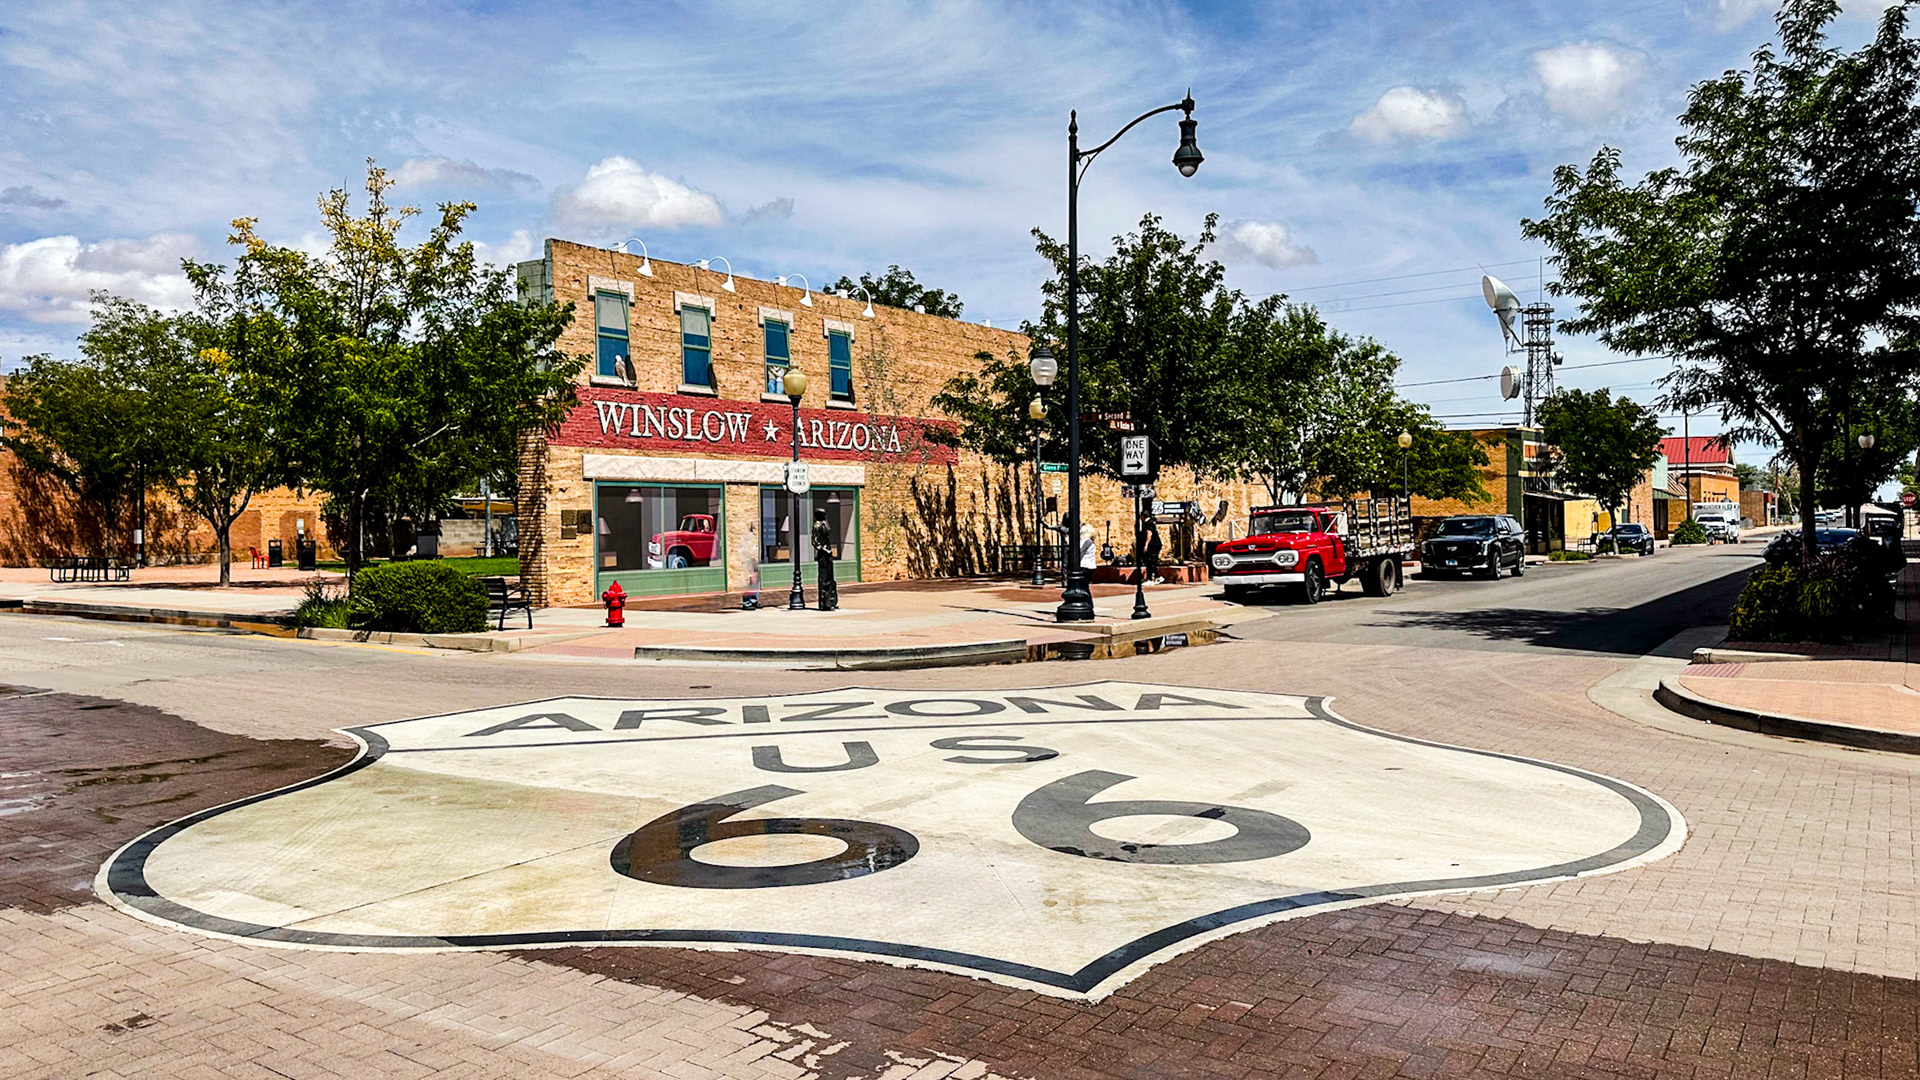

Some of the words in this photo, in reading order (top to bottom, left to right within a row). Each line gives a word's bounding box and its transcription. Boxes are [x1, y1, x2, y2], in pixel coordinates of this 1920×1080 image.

[593, 400, 752, 444] WINSLOW
[790, 417, 902, 453] ARIZONA
[1126, 440, 1145, 449] ONE
[1126, 450, 1145, 460] WAY
[464, 692, 1247, 738] ARIZONA
